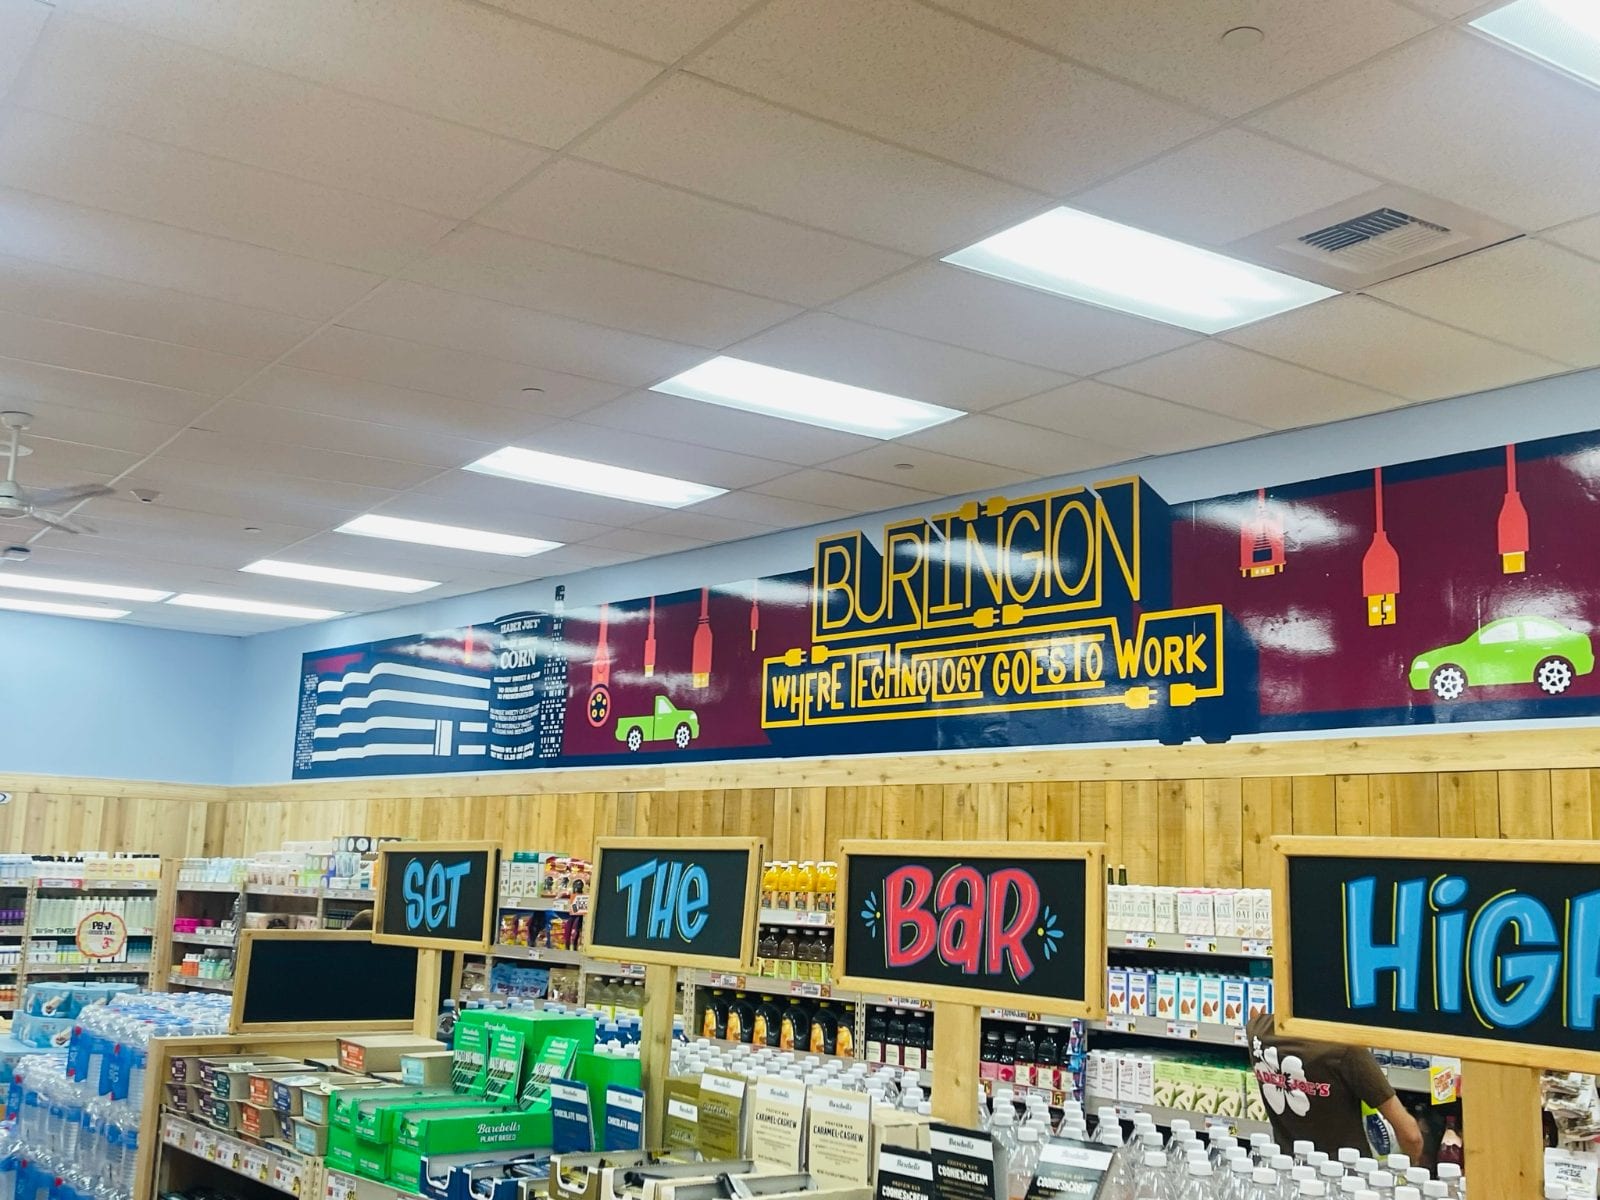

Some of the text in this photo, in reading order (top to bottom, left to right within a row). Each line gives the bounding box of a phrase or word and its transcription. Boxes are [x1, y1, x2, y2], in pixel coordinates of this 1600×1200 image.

[820, 476, 1139, 632] BURLINGTON
[500, 648, 536, 670] CORN
[771, 660, 845, 713] WHERE
[850, 650, 986, 708] TECHNOLOGY
[992, 647, 1067, 696] GOES
[1116, 628, 1208, 680] WORK
[1254, 1069, 1330, 1097] ADER JOE'S
[477, 1121, 521, 1134] Barebells
[479, 1134, 498, 1143] PLANT
